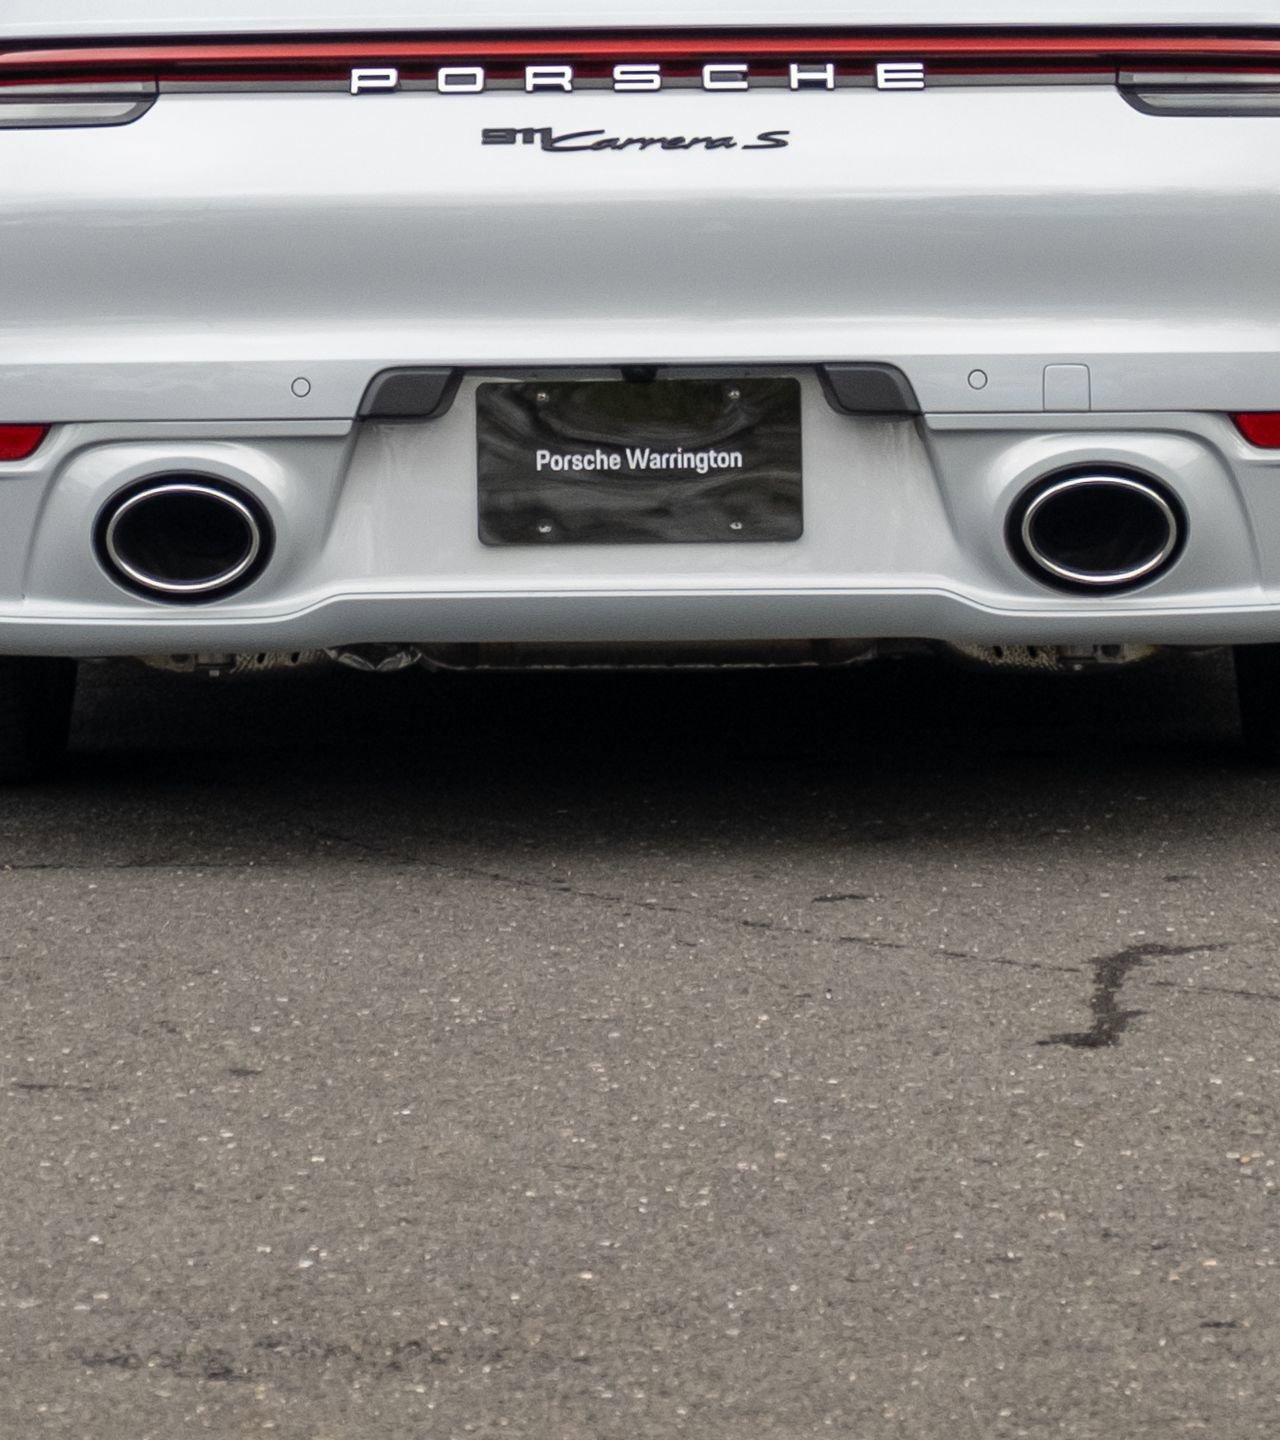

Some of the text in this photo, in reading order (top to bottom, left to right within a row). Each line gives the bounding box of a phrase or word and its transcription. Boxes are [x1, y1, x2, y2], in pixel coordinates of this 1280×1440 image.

[350, 63, 925, 93] PORSCHE
[542, 129, 737, 152] Carrera
[741, 130, 790, 149] S
[536, 448, 743, 474] Porsche Warrington
